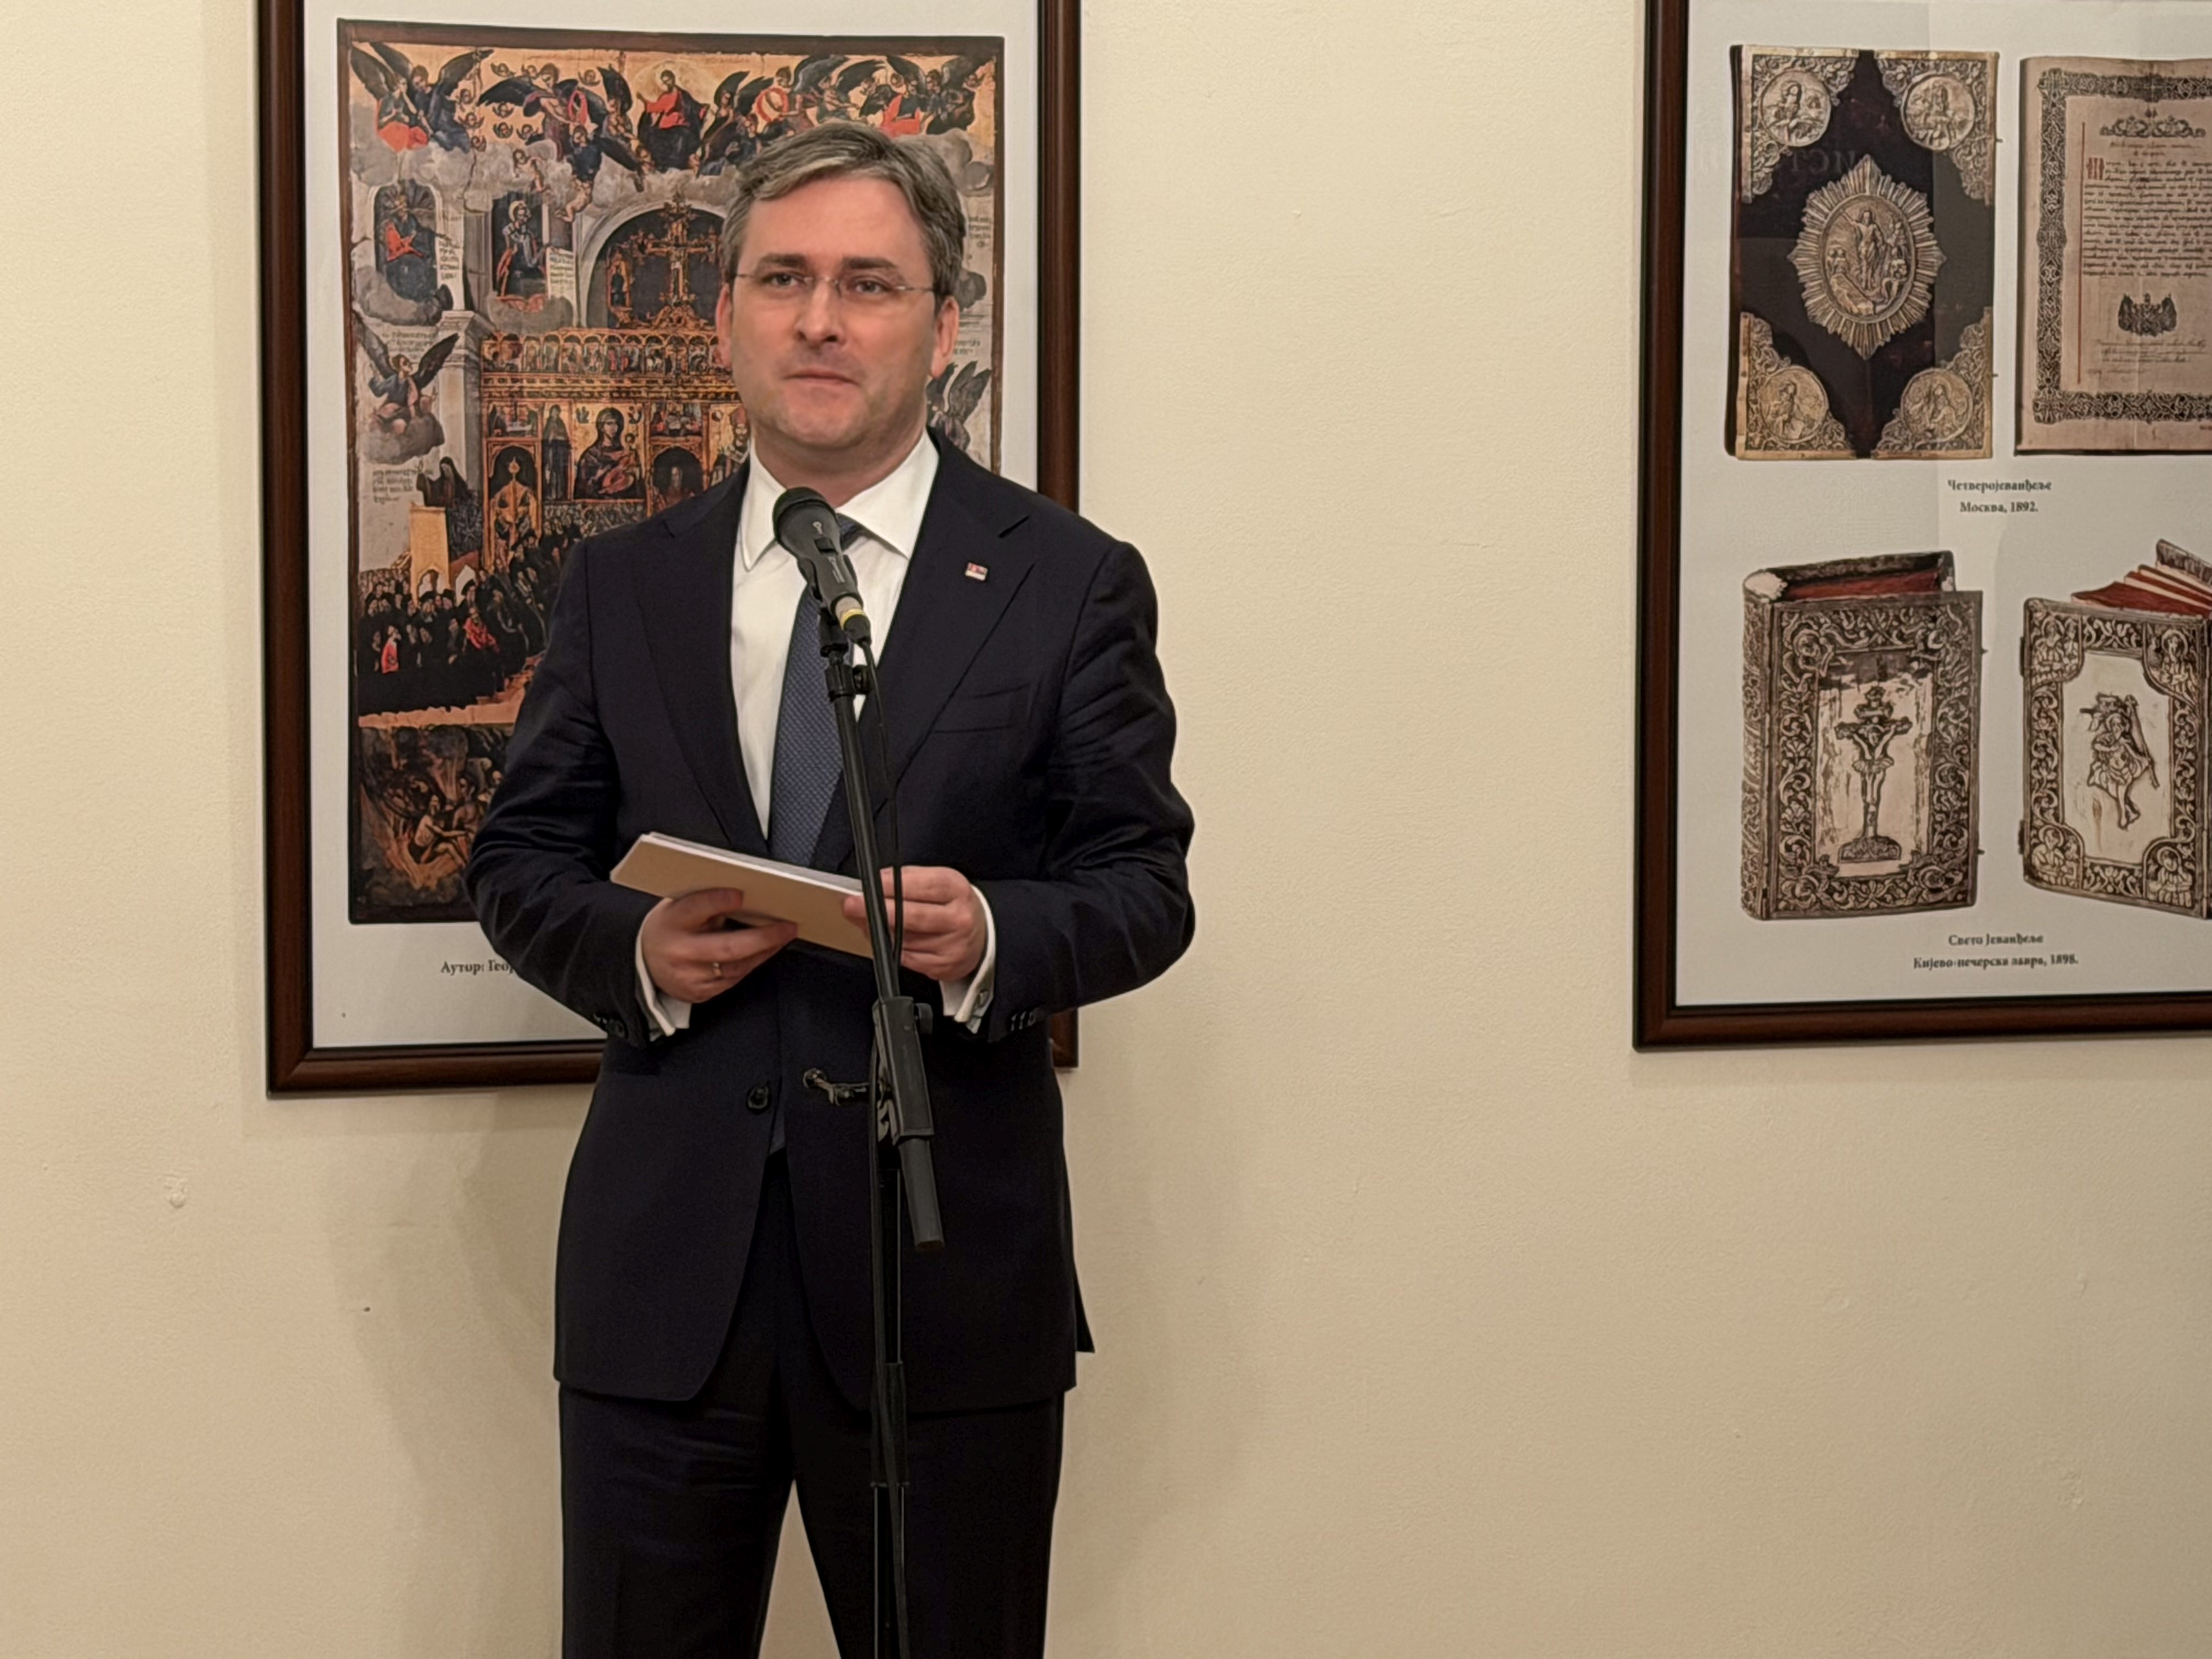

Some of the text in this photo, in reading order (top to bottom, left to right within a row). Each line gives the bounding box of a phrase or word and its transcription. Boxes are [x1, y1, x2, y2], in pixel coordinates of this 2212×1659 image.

[1960, 501, 2039, 514] Москва, 1892.
[441, 961, 484, 976] Аутор:
